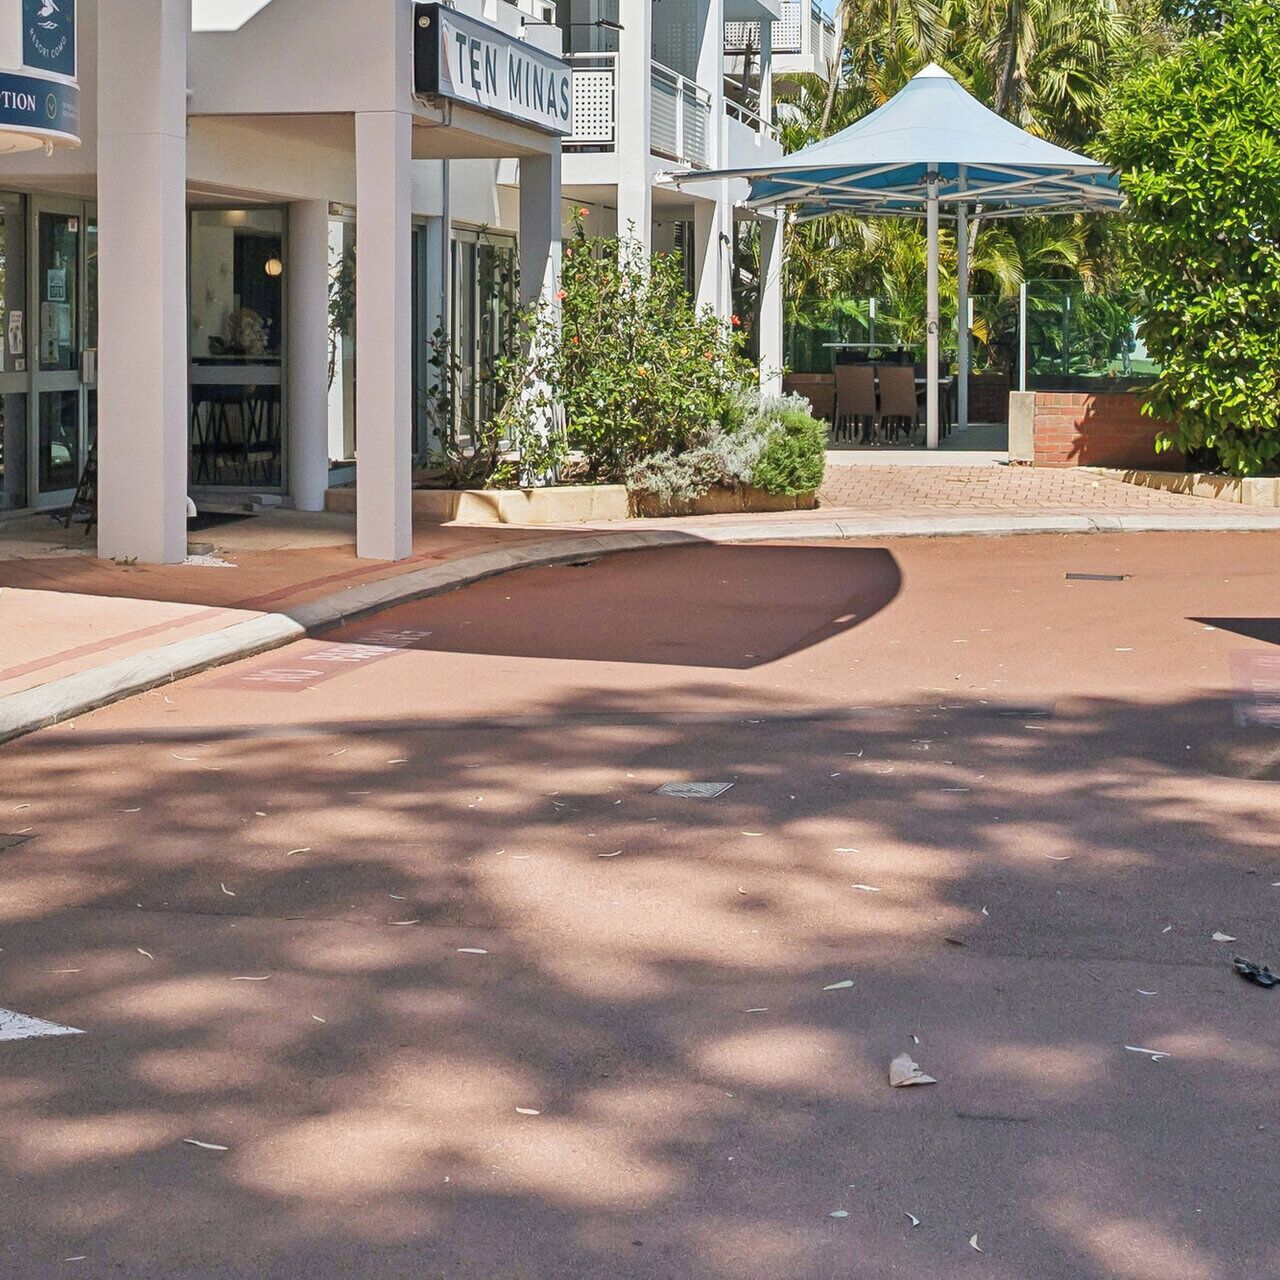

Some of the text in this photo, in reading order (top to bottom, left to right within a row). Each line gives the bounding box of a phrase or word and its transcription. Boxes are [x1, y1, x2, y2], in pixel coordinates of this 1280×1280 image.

[29, 27, 67, 59] RESORT COMO
[455, 32, 570, 121] TEN MINAS
